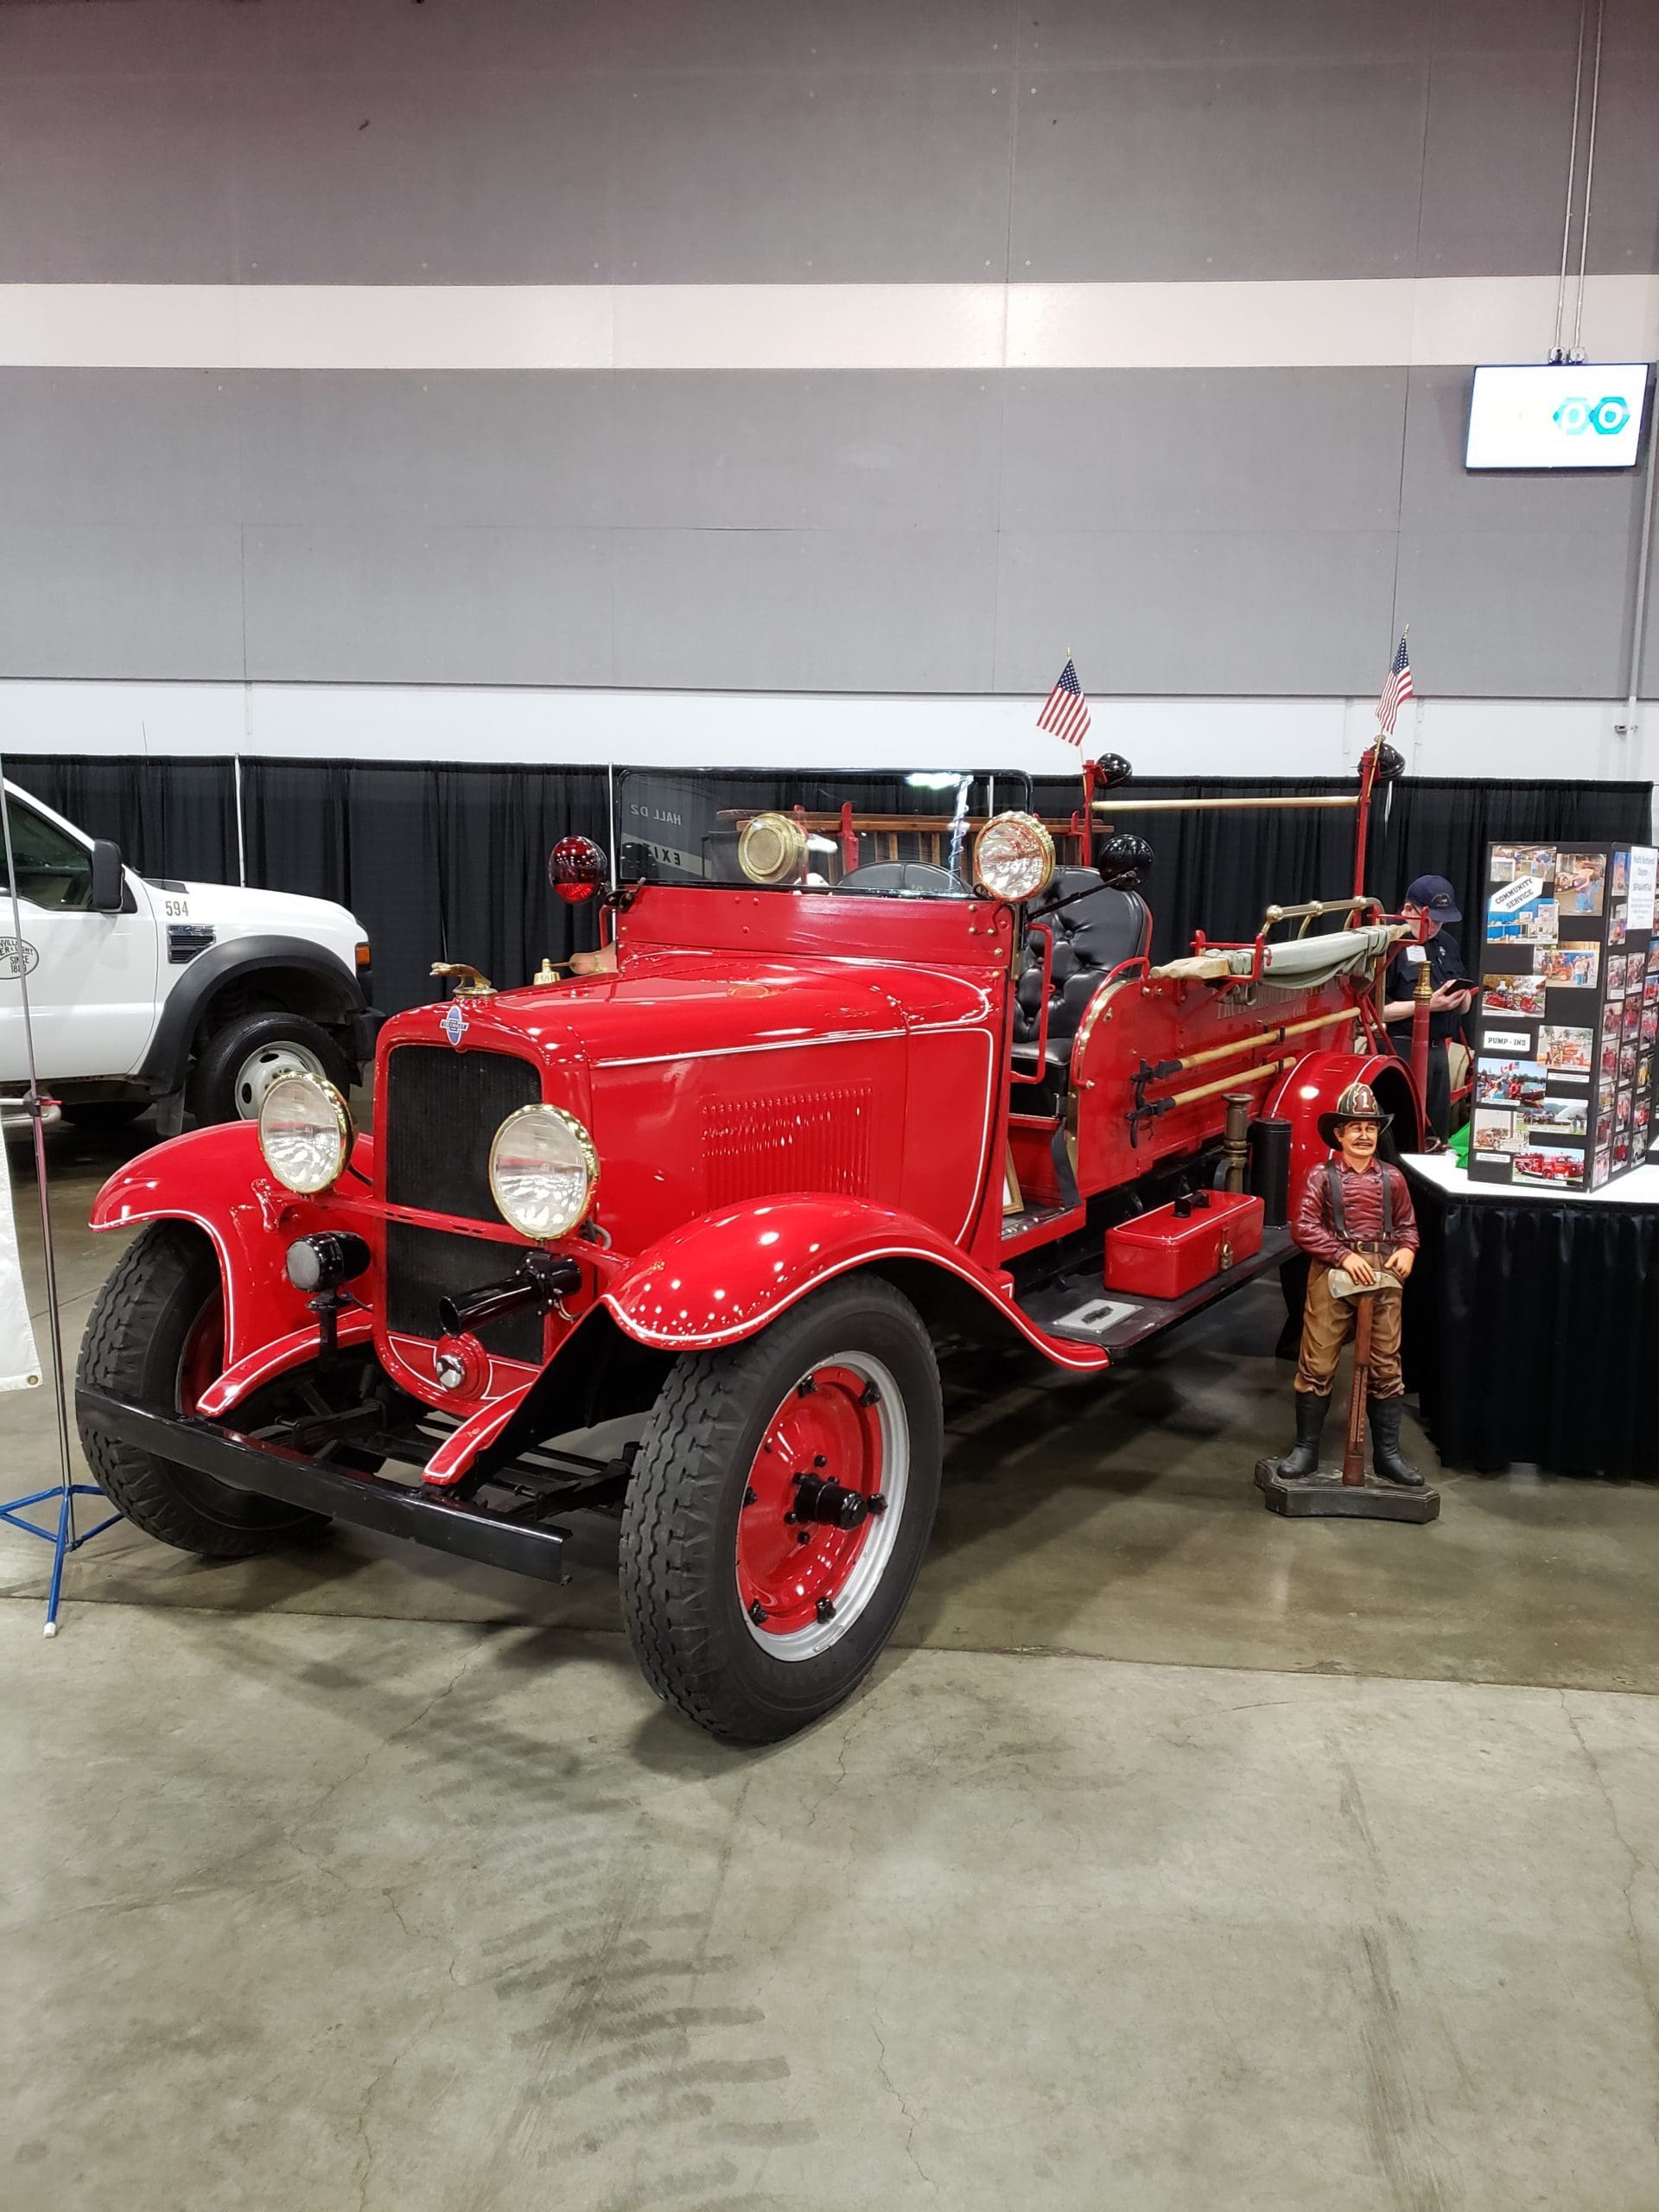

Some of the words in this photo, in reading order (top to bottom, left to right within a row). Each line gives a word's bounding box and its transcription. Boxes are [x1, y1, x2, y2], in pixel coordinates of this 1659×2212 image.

[1495, 877, 1534, 905] COMMUNITY
[1506, 888, 1534, 909] SERVICE
[165, 900, 189, 917] 594
[1361, 1090, 1370, 1109] 1
